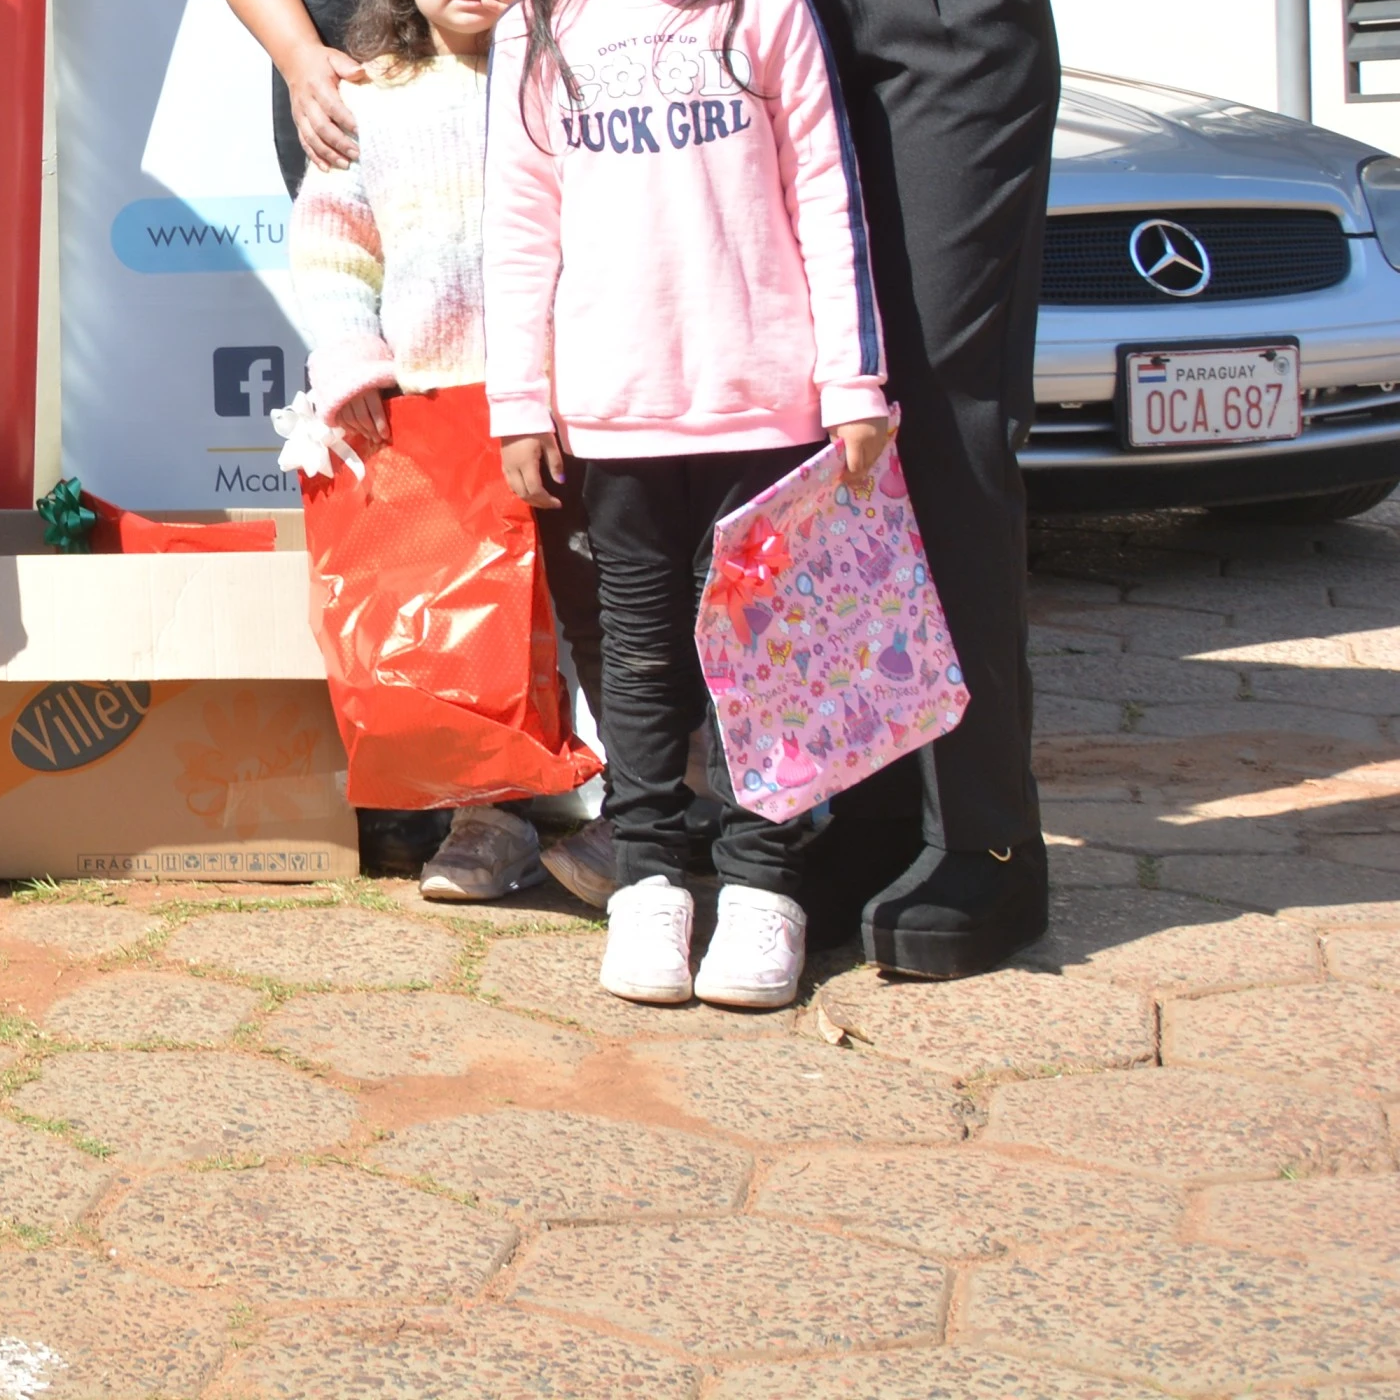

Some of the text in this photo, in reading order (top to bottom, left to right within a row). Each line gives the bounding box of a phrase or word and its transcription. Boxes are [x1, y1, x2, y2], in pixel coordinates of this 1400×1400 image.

[598, 34, 698, 56] DON'T GIVE UP
[561, 100, 751, 154] LUCK GIRL
[1176, 364, 1256, 382] PARAGUAY
[1224, 383, 1283, 430] 687
[215, 464, 297, 493] Mcal.
[84, 853, 153, 870] FRÁGIL
